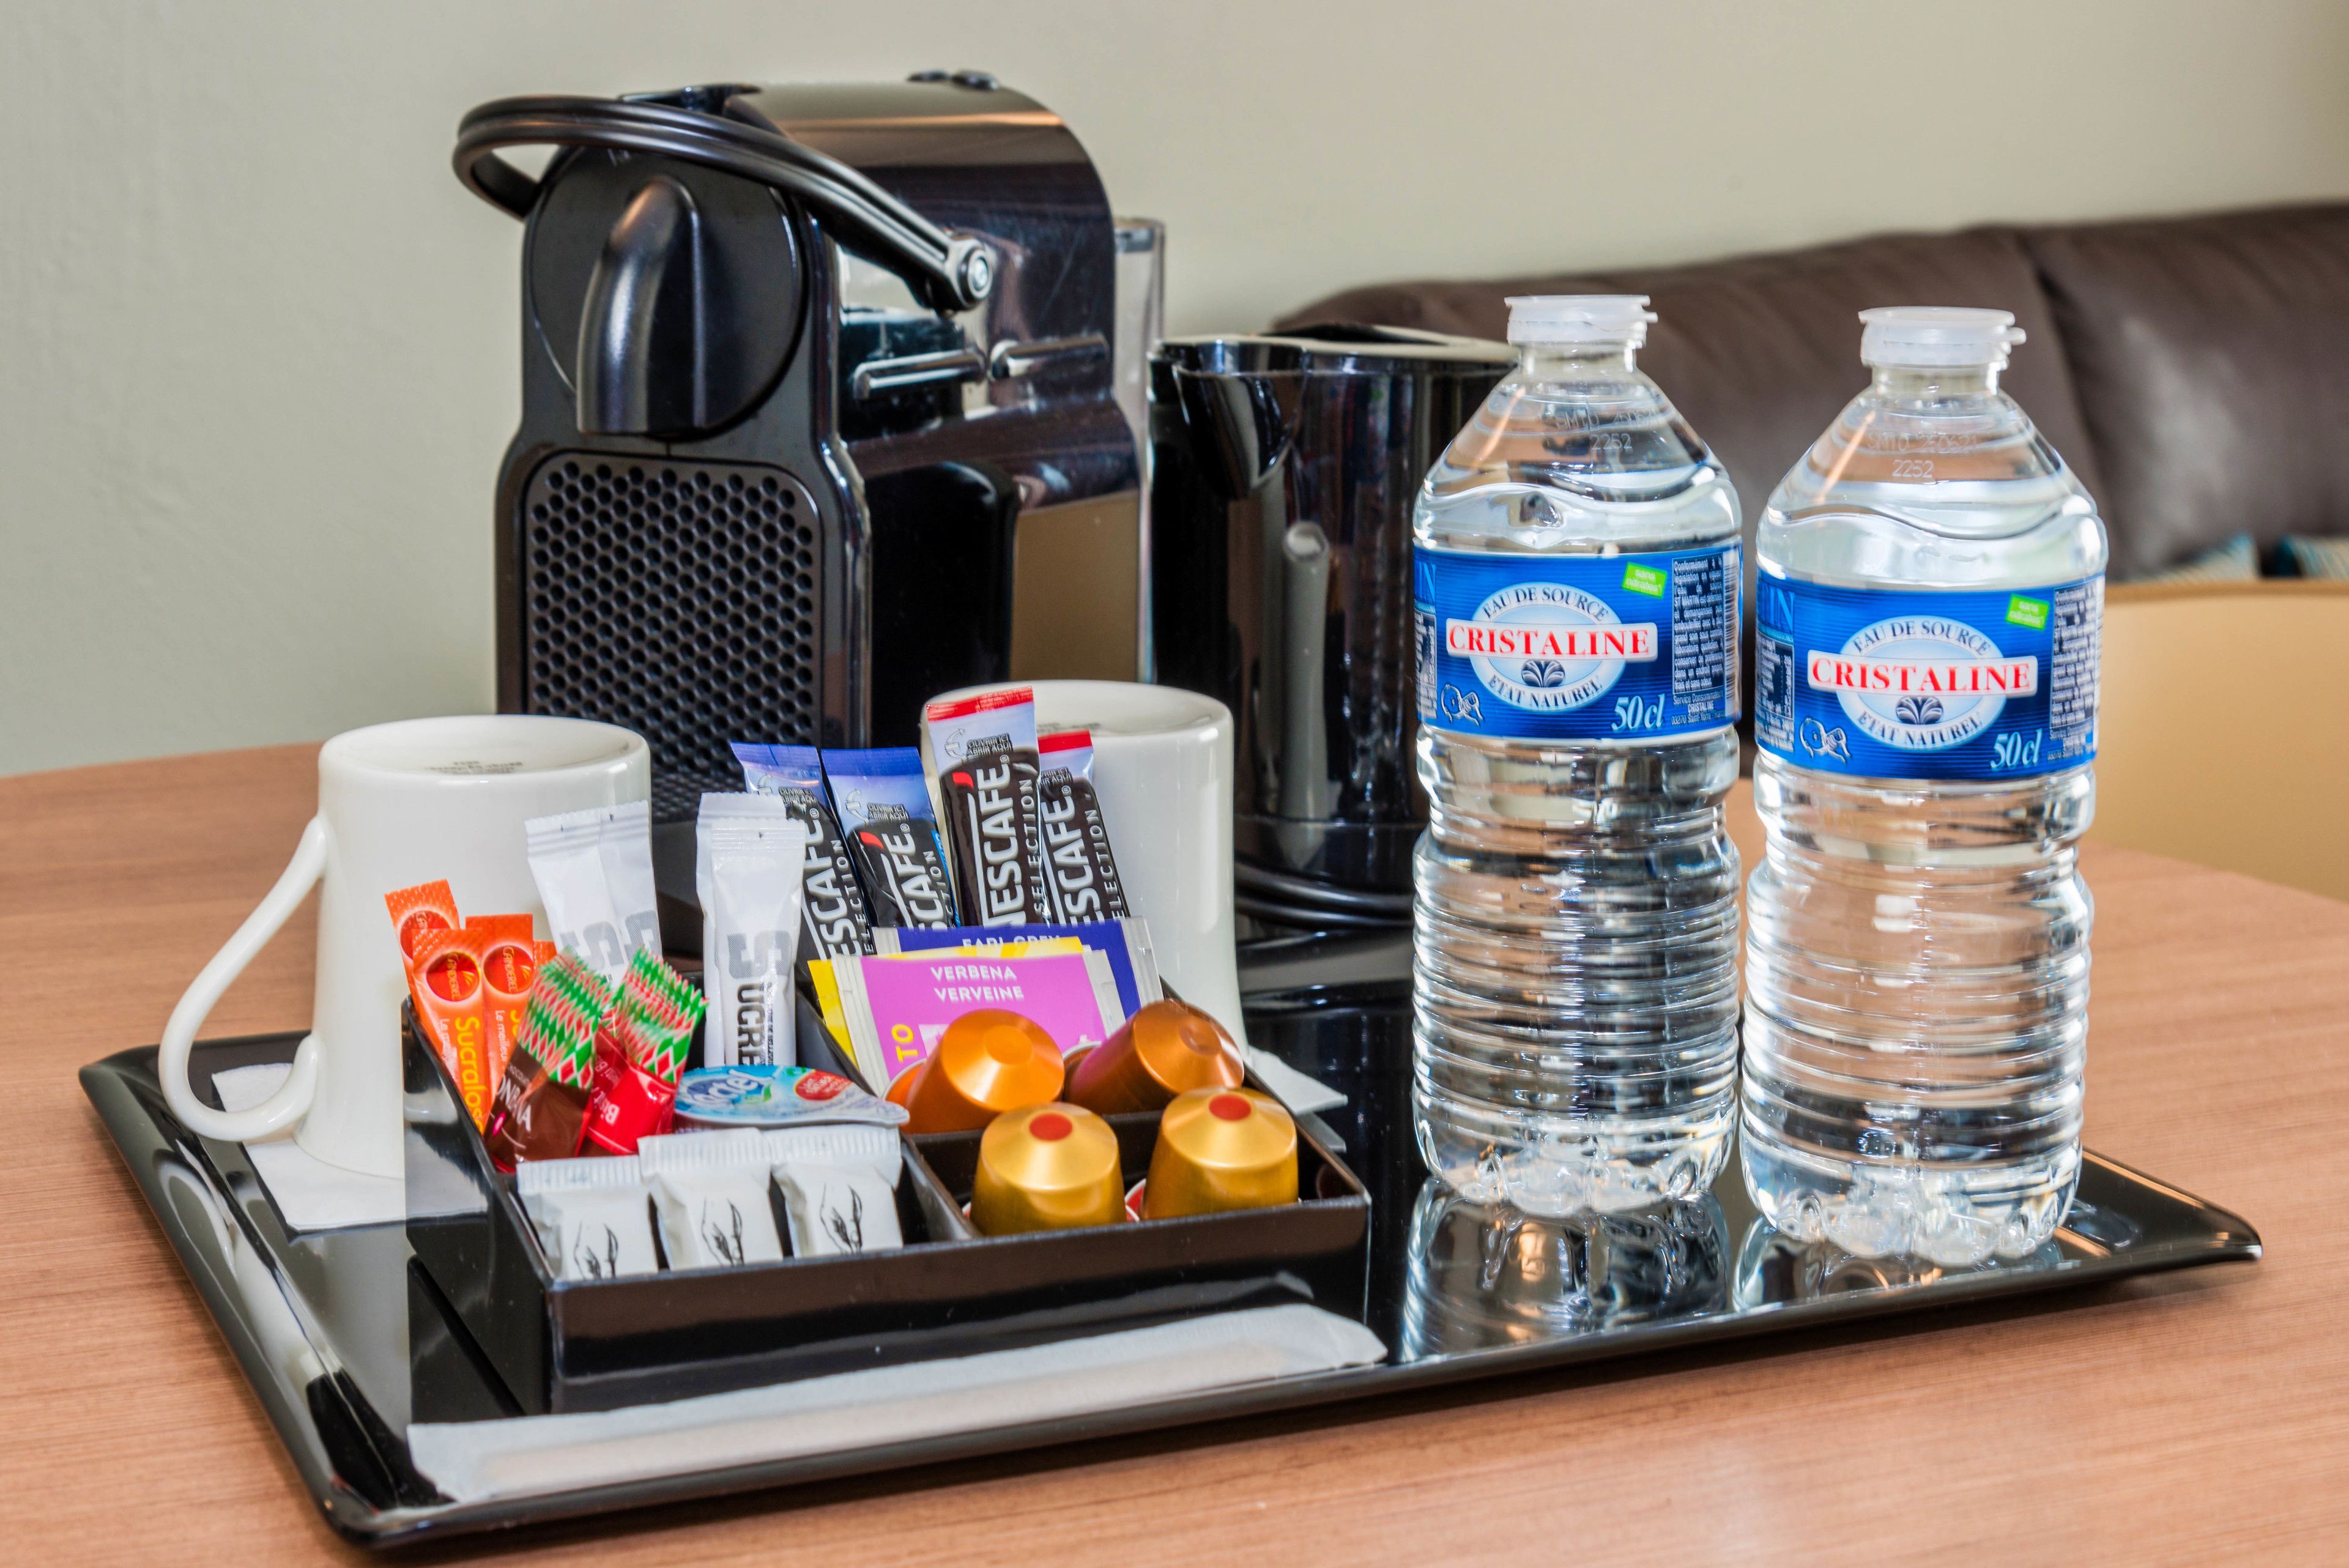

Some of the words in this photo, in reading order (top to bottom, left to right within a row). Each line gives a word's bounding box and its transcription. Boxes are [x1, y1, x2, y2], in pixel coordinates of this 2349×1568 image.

[1892, 459, 1934, 478] 2252
[1482, 591, 1511, 619] EAU
[1513, 586, 1537, 603] DE
[1542, 587, 1609, 622] SOURCE
[1449, 625, 1650, 656] CRISTALINE
[1853, 625, 1886, 652] EAU
[1890, 620, 1916, 637] DE
[1920, 620, 1991, 656] SOURCE
[1487, 674, 1525, 704] ETAT
[1528, 676, 1603, 708] NATUREL
[1813, 658, 2030, 692] CRISTALINE
[1611, 693, 1666, 732] 50cl
[1857, 711, 1899, 741] ETAT
[1904, 716, 1983, 746] NATUREL
[968, 738, 998, 748] OUVRIR
[1000, 734, 1010, 744] ICI
[991, 741, 1012, 753] AQUI
[1990, 728, 2042, 771] 50cl
[1085, 809, 1124, 920] ELECTION
[831, 840, 874, 954] ELECTION
[503, 945, 518, 993] CANDEREL
[930, 965, 1018, 980] VERBENA
[933, 985, 1025, 1002] VERVEINE
